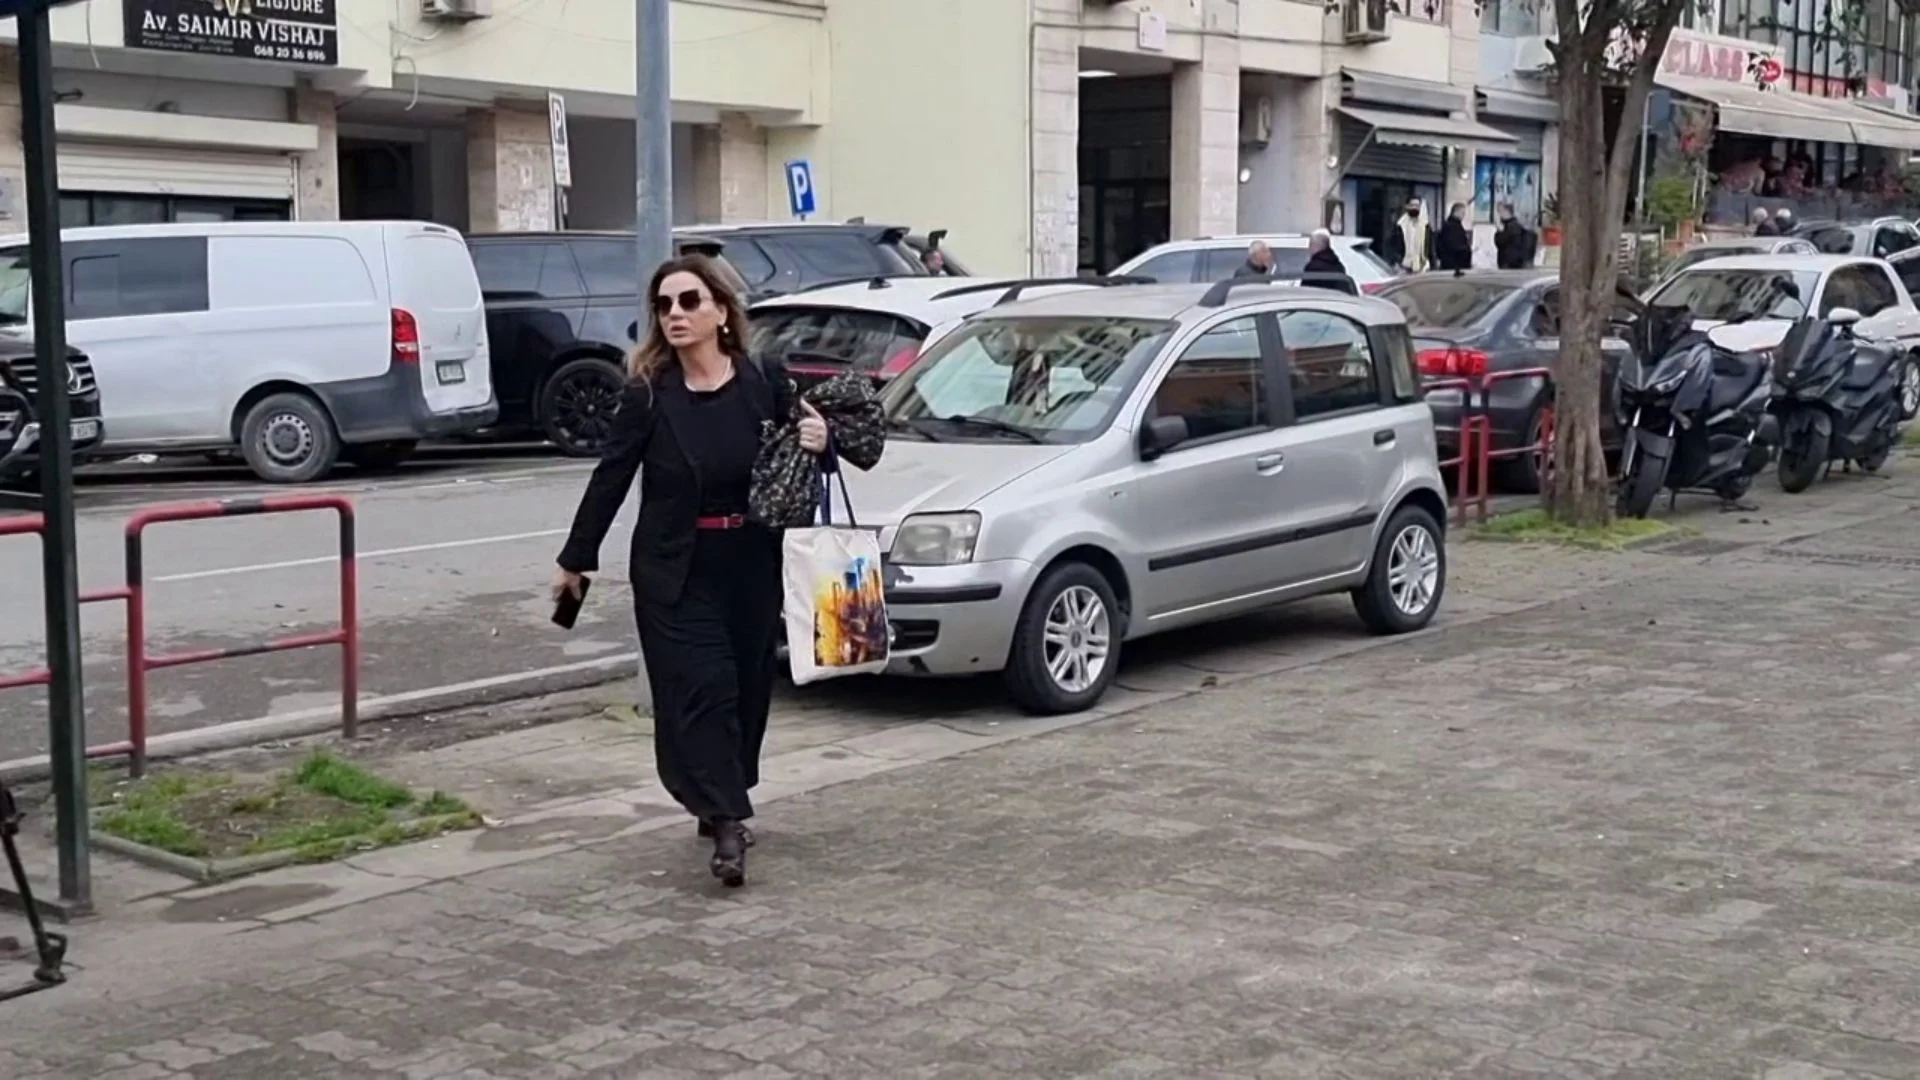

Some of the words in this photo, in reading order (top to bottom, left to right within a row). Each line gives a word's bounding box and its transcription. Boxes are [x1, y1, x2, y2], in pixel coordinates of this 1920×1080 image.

[142, 9, 172, 32] Av.
[178, 13, 252, 39] SAIMIR
[256, 21, 324, 46] VISHAJ
[254, 44, 274, 56] 068
[276, 47, 289, 58] 20
[1662, 37, 1744, 81] CLASS
[552, 101, 563, 140] P
[791, 166, 808, 210] P
